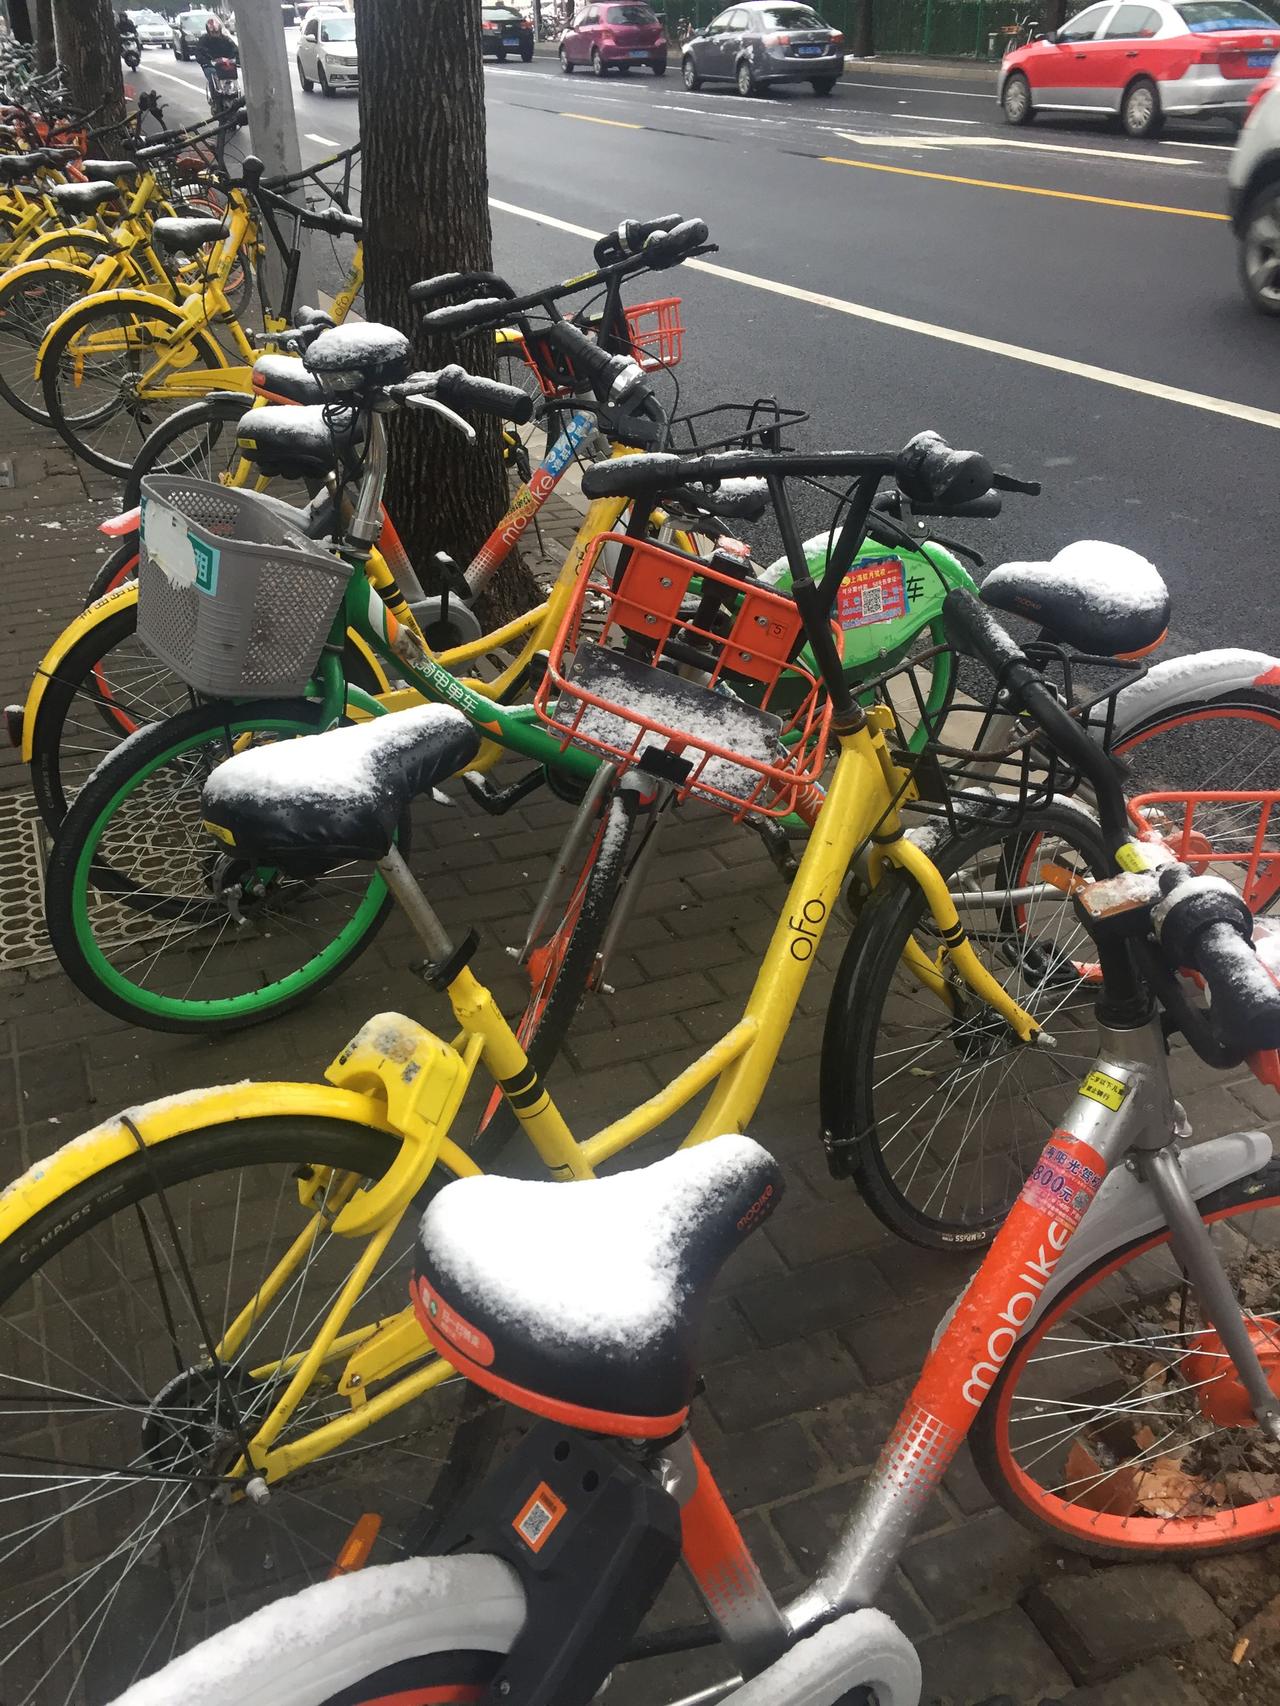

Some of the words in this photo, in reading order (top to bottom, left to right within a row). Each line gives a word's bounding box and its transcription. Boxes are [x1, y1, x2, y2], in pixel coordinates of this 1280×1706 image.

[335, 296, 350, 317] ofo
[790, 899, 826, 961] ofo
[1031, 1164, 1073, 1203] 800元
[961, 1220, 1072, 1408] mobike
